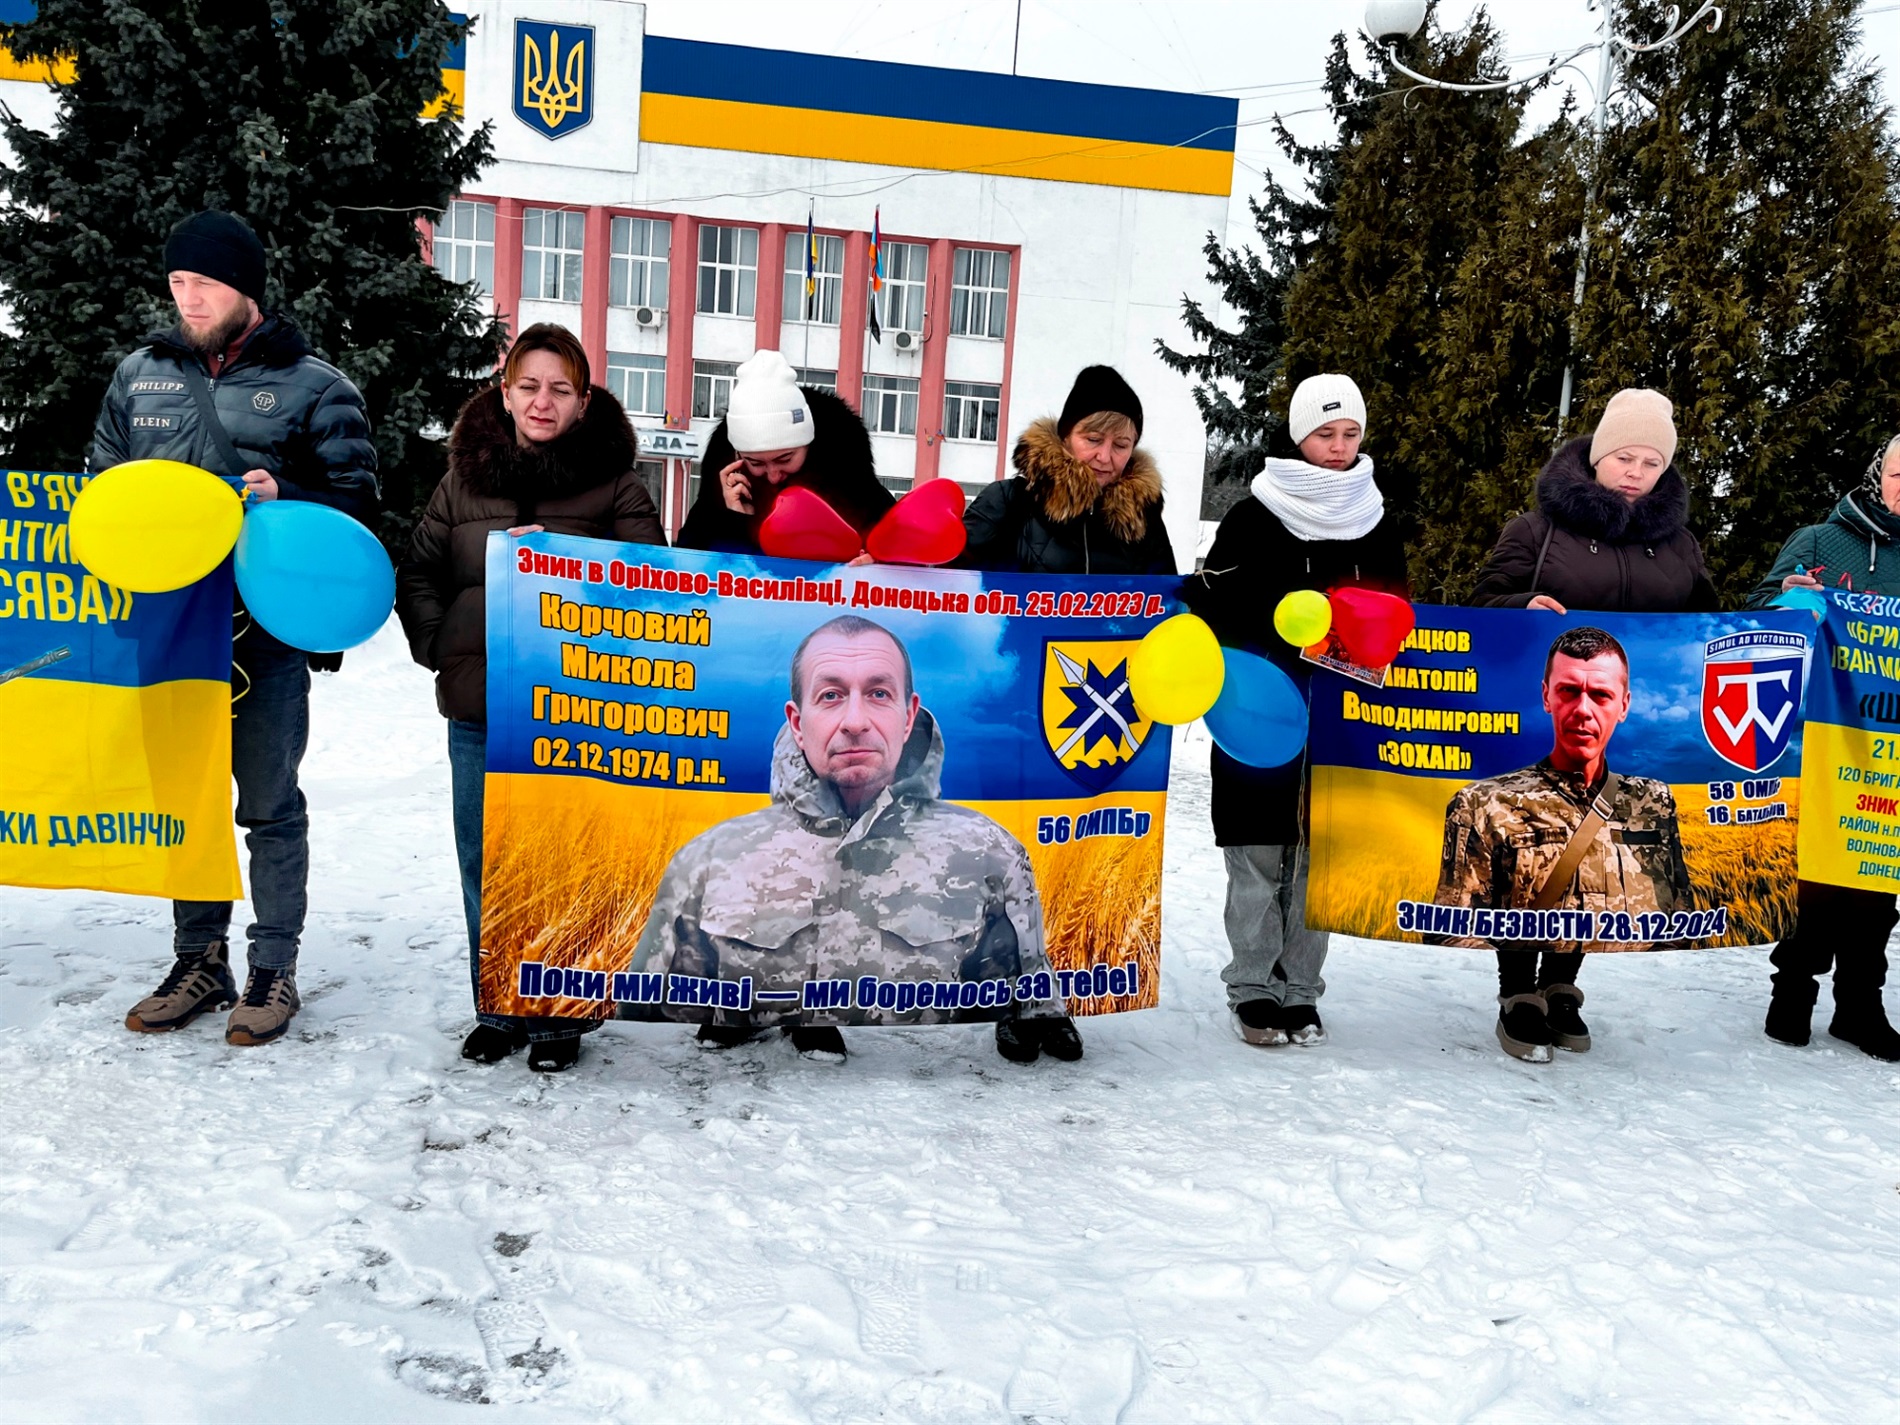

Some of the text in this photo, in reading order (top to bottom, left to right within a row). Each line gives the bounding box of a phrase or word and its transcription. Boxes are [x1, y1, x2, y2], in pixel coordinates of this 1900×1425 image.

[130, 381, 185, 392] PHILIPP
[132, 416, 171, 428] PLEIN
[0, 518, 80, 565] НТИ
[517, 547, 1165, 619] Зник в Оріхово-Василівці, Донецька обл. 25.02.2023 р.
[540, 591, 711, 646] Корчовий
[1398, 628, 1472, 653] АЦКОВ
[1708, 634, 1804, 654] SIMUL AD VICTORIAM
[1846, 620, 1900, 650] «БРИ
[561, 642, 695, 692] Микола
[1831, 645, 1877, 675] ІВАН
[532, 686, 730, 739] Григорович
[532, 736, 727, 785] 02.12.1974 р.н.
[1377, 740, 1472, 771] «ЗОХАН»
[1837, 765, 1861, 783] 120
[1708, 781, 1736, 801] 58
[1855, 793, 1900, 817] ЗНИК
[1705, 805, 1730, 824] 16
[1839, 815, 1880, 835] РАЙОН
[48, 812, 186, 848] ДАВІНЧІ»
[1037, 815, 1072, 845] 56
[1397, 901, 1727, 941] ЗНИК БЕЗВІСТИ 28.12.2024
[518, 961, 606, 1001] Поки
[611, 973, 664, 1004] ми
[667, 974, 752, 1011] живі
[802, 980, 852, 1010] ми
[856, 975, 1011, 1013] боремось
[1015, 971, 1052, 1001] за
[1056, 962, 1139, 998] тебе!
